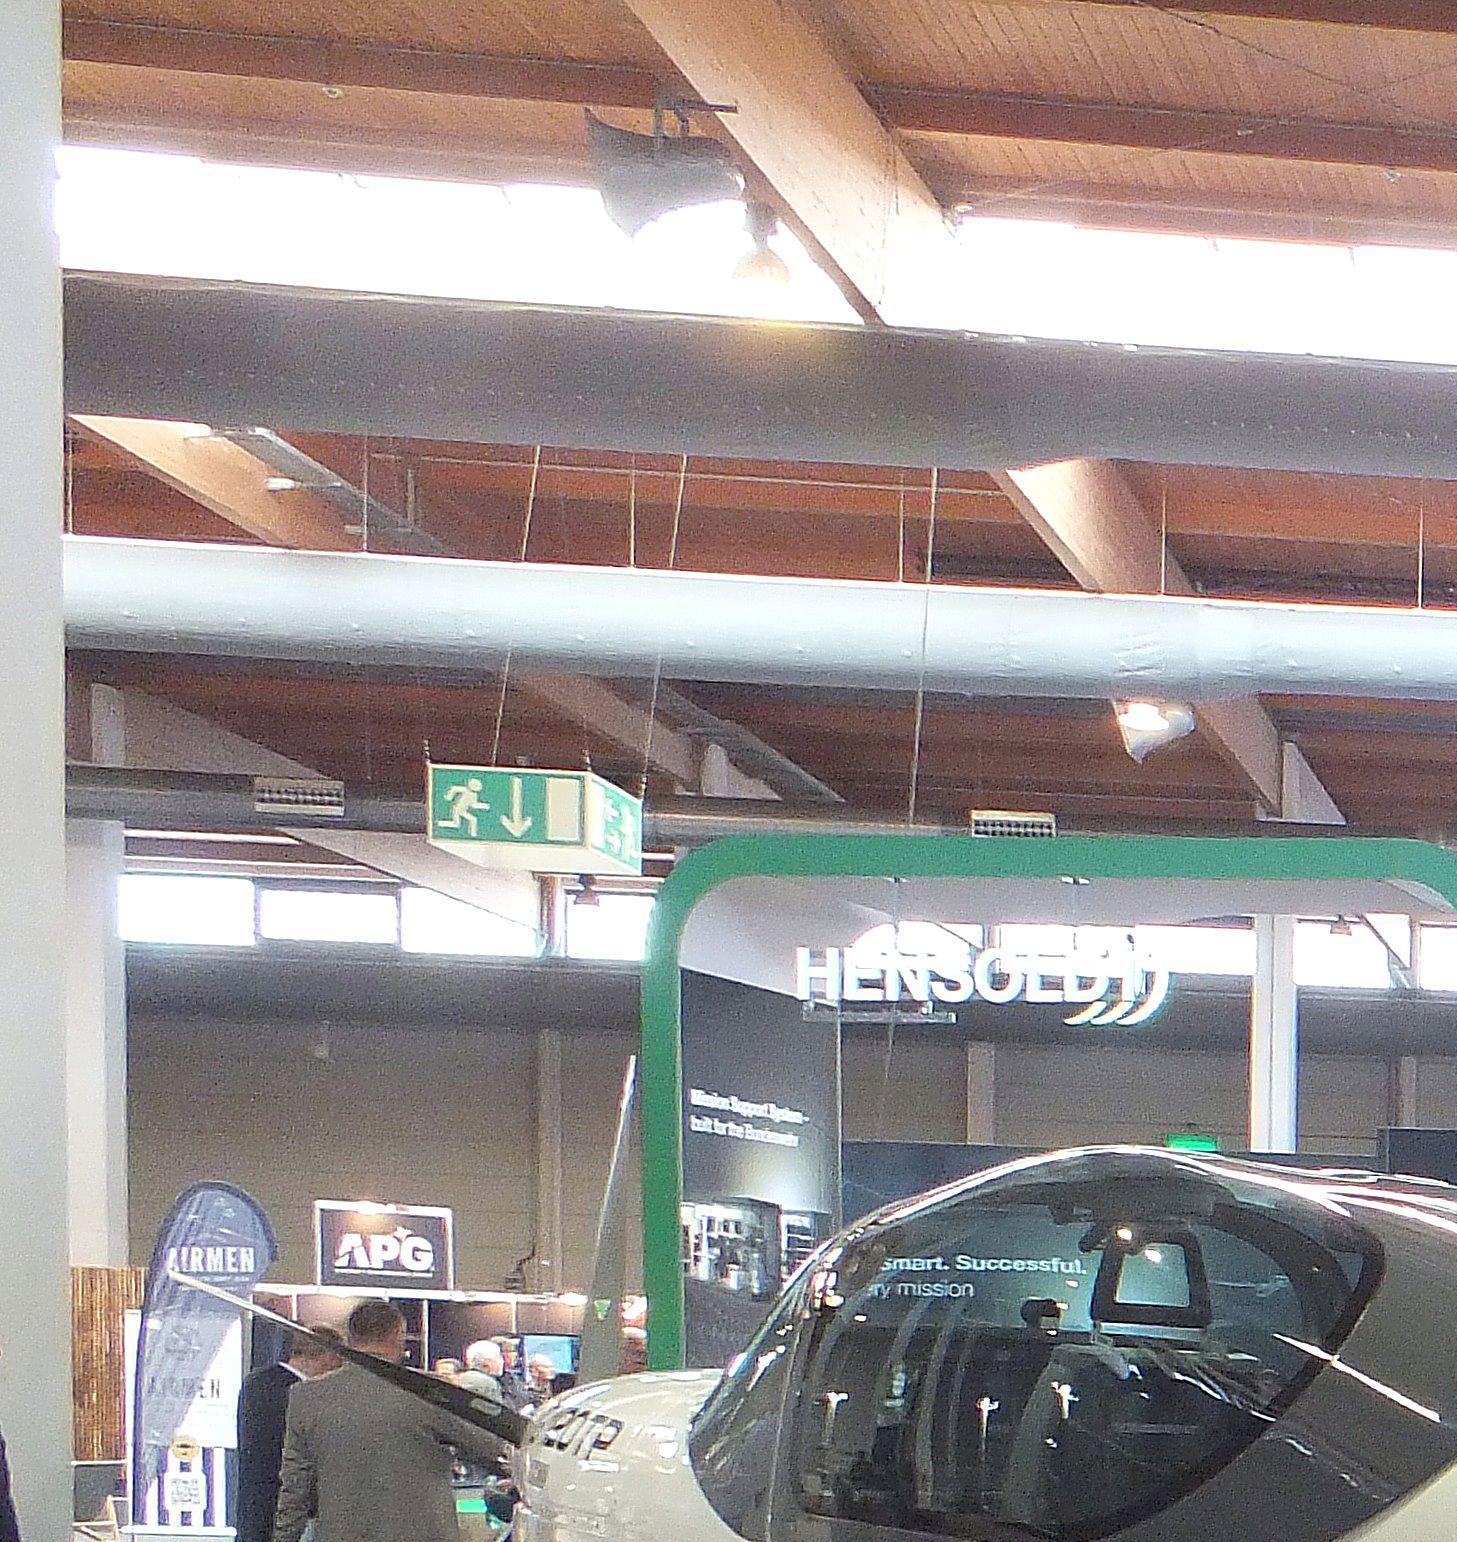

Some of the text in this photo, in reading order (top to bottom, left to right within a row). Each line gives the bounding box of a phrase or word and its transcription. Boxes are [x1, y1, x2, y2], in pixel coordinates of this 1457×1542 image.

[168, 1246, 255, 1273] AIRMEN
[335, 1231, 434, 1272] APG
[956, 1254, 1088, 1275] Successful.
[897, 1280, 975, 1298] mission
